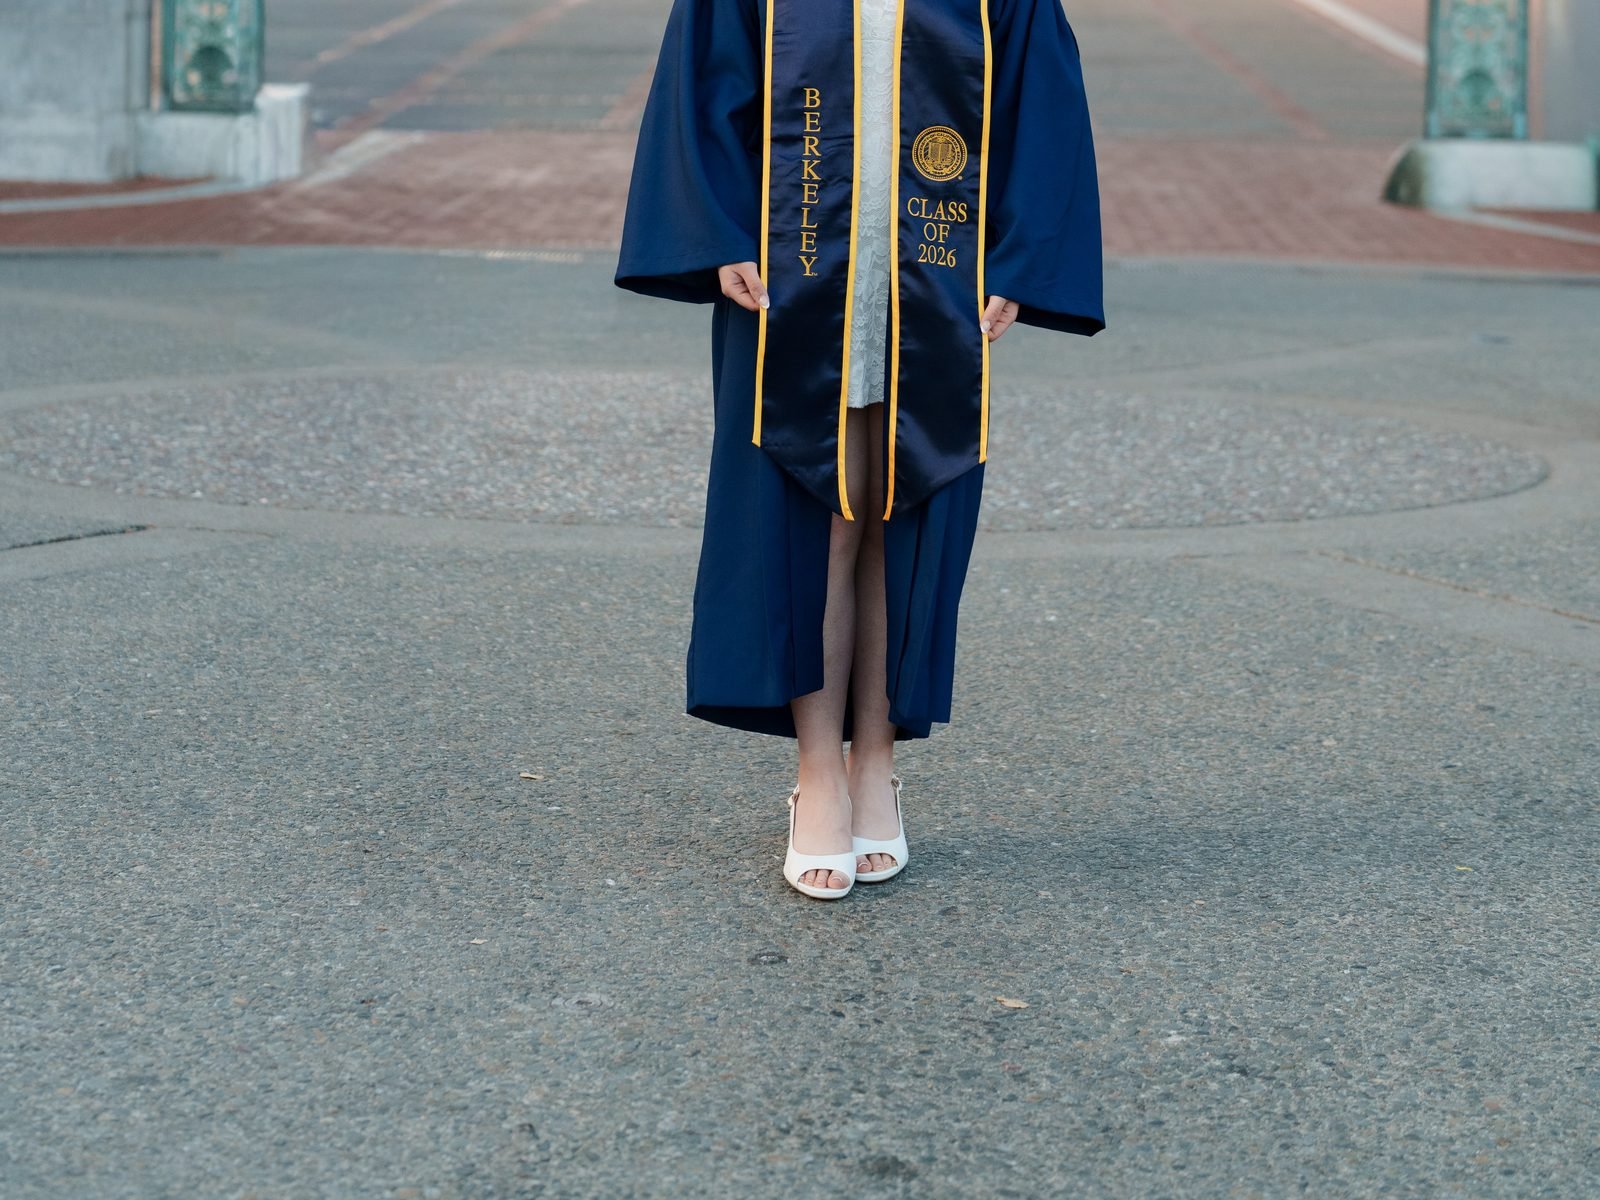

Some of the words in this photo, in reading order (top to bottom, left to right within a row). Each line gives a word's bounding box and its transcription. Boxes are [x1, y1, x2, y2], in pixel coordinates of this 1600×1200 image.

[798, 87, 821, 276] BERKELEY
[907, 197, 968, 223] CLASS
[923, 222, 950, 244] OF
[917, 243, 957, 268] 2026
